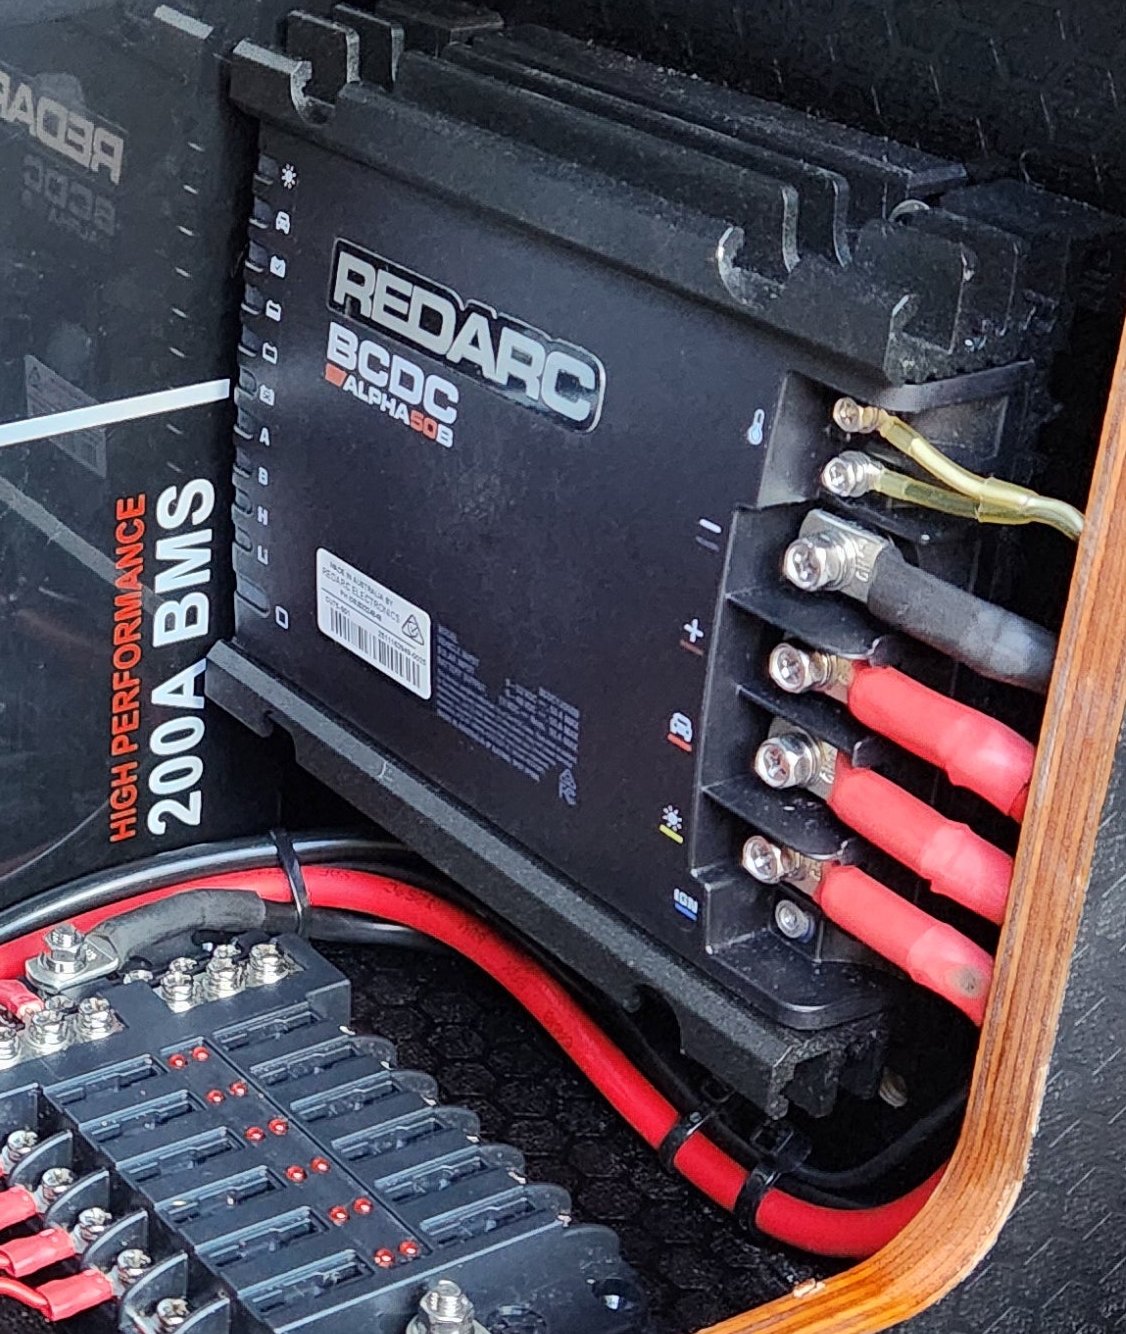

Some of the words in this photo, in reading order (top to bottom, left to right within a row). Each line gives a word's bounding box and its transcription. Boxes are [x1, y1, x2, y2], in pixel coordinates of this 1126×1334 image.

[327, 321, 459, 424] BCDC
[333, 251, 597, 422] REDARC
[258, 467, 268, 486] B
[259, 427, 270, 447] A
[152, 477, 216, 648] BMS
[257, 505, 268, 526] H
[111, 493, 146, 758] PERFORMANCE
[147, 657, 207, 836] 200A
[110, 762, 138, 843] HIGH
